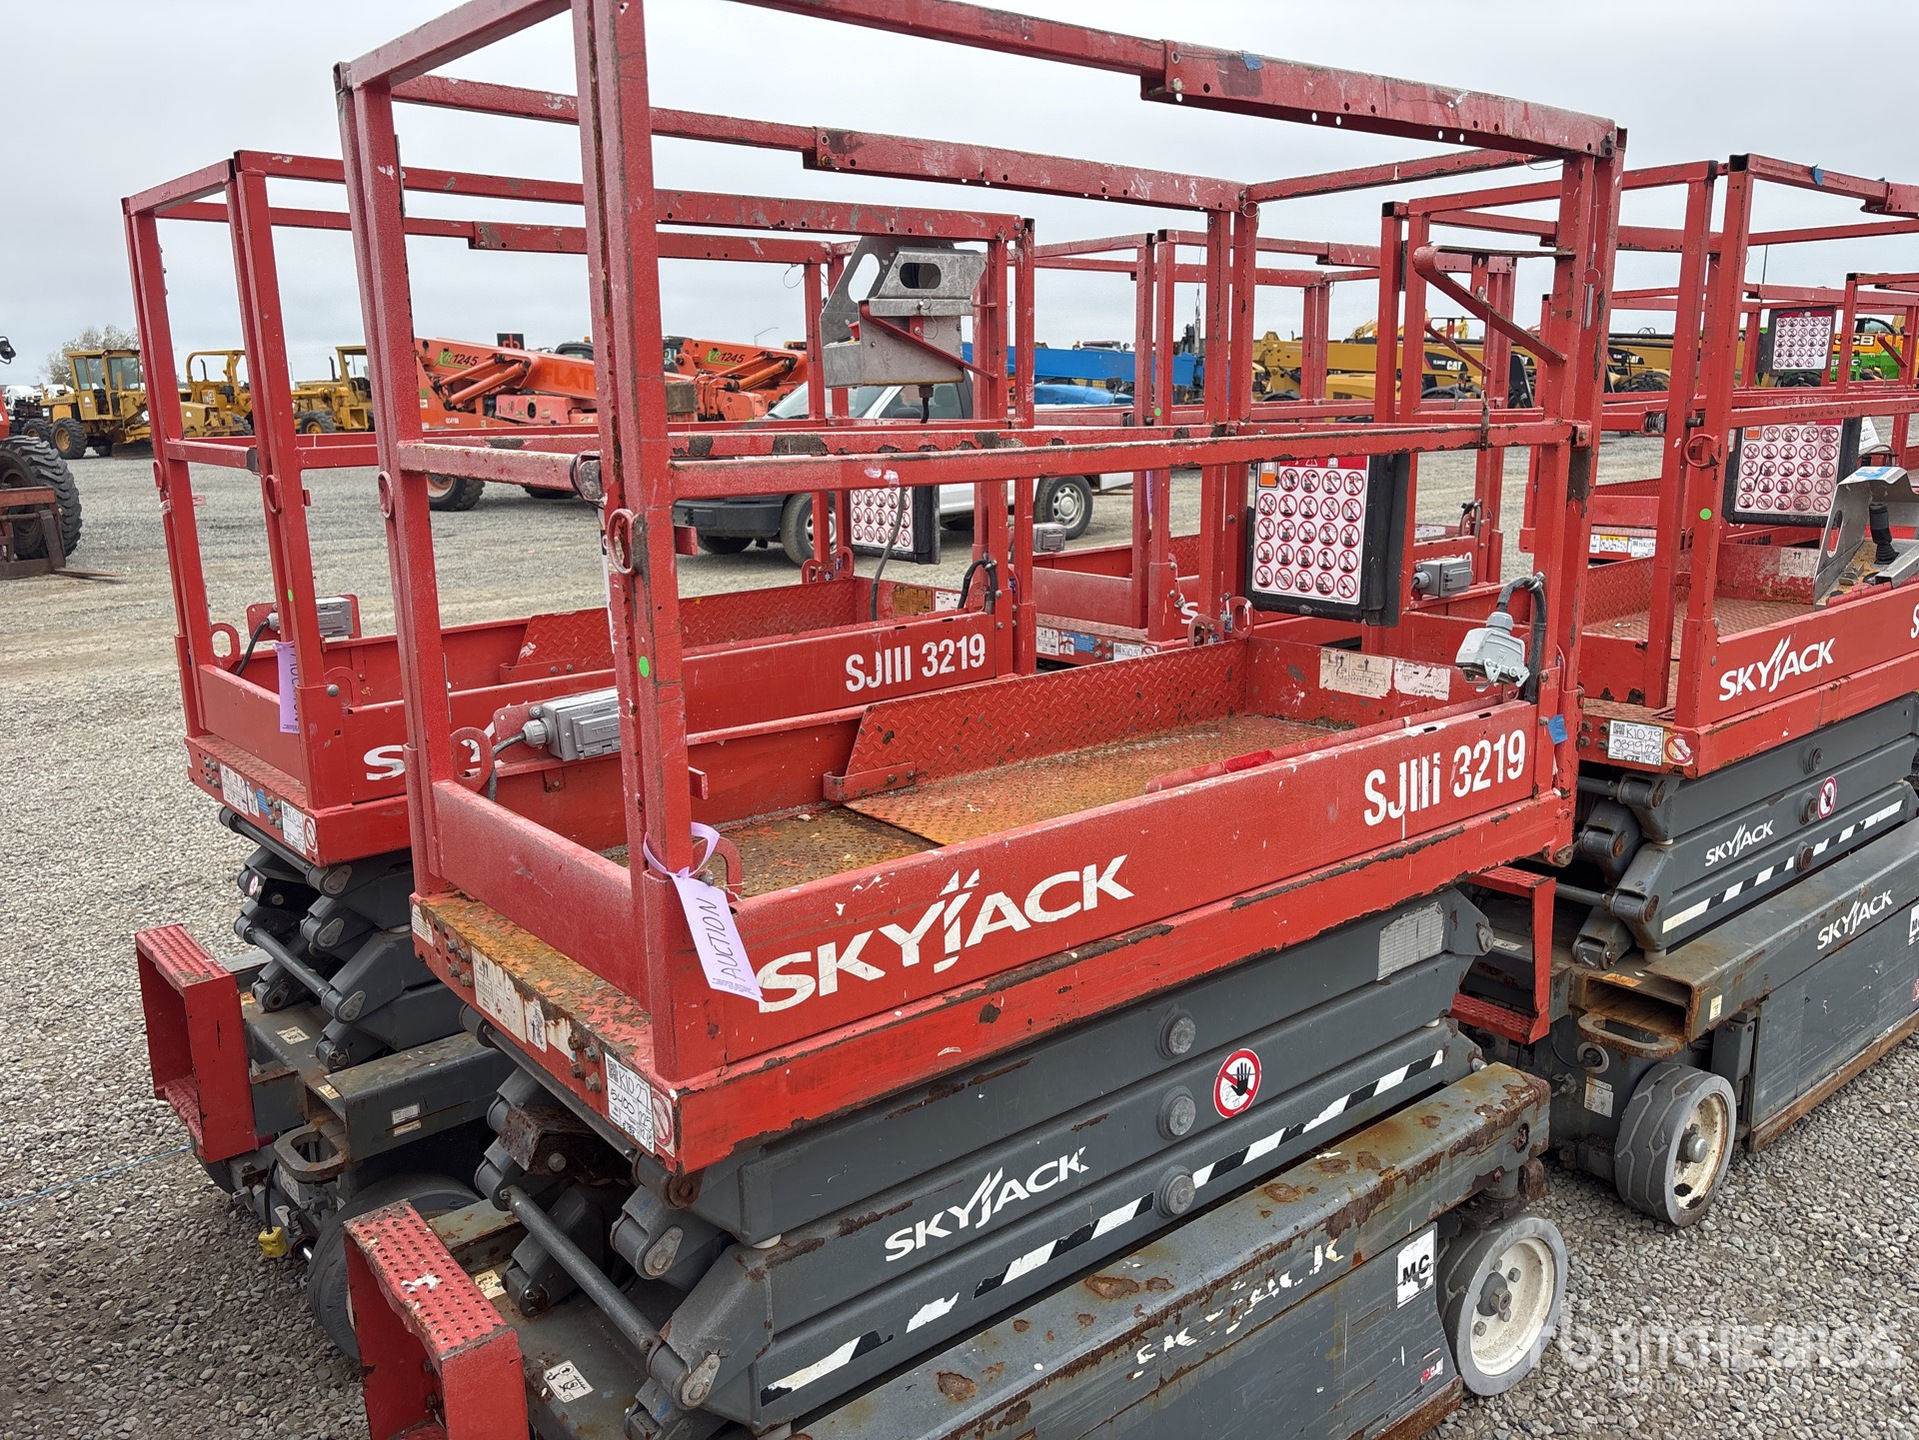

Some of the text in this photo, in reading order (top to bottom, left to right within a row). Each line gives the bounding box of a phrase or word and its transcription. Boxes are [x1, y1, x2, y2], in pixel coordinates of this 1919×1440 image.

[1446, 360, 1463, 371] CAT
[845, 645, 912, 692] SJIII
[921, 633, 986, 678] 3219
[1718, 634, 1836, 702] SKYJACK
[1453, 729, 1526, 798] 3219
[1704, 819, 1774, 867] SKYJACK
[696, 897, 746, 982] AUCTION
[756, 854, 1136, 1014] SKYJACK
[1816, 889, 1893, 951] SKYJACK
[884, 1146, 1090, 1262] SKYJACK
